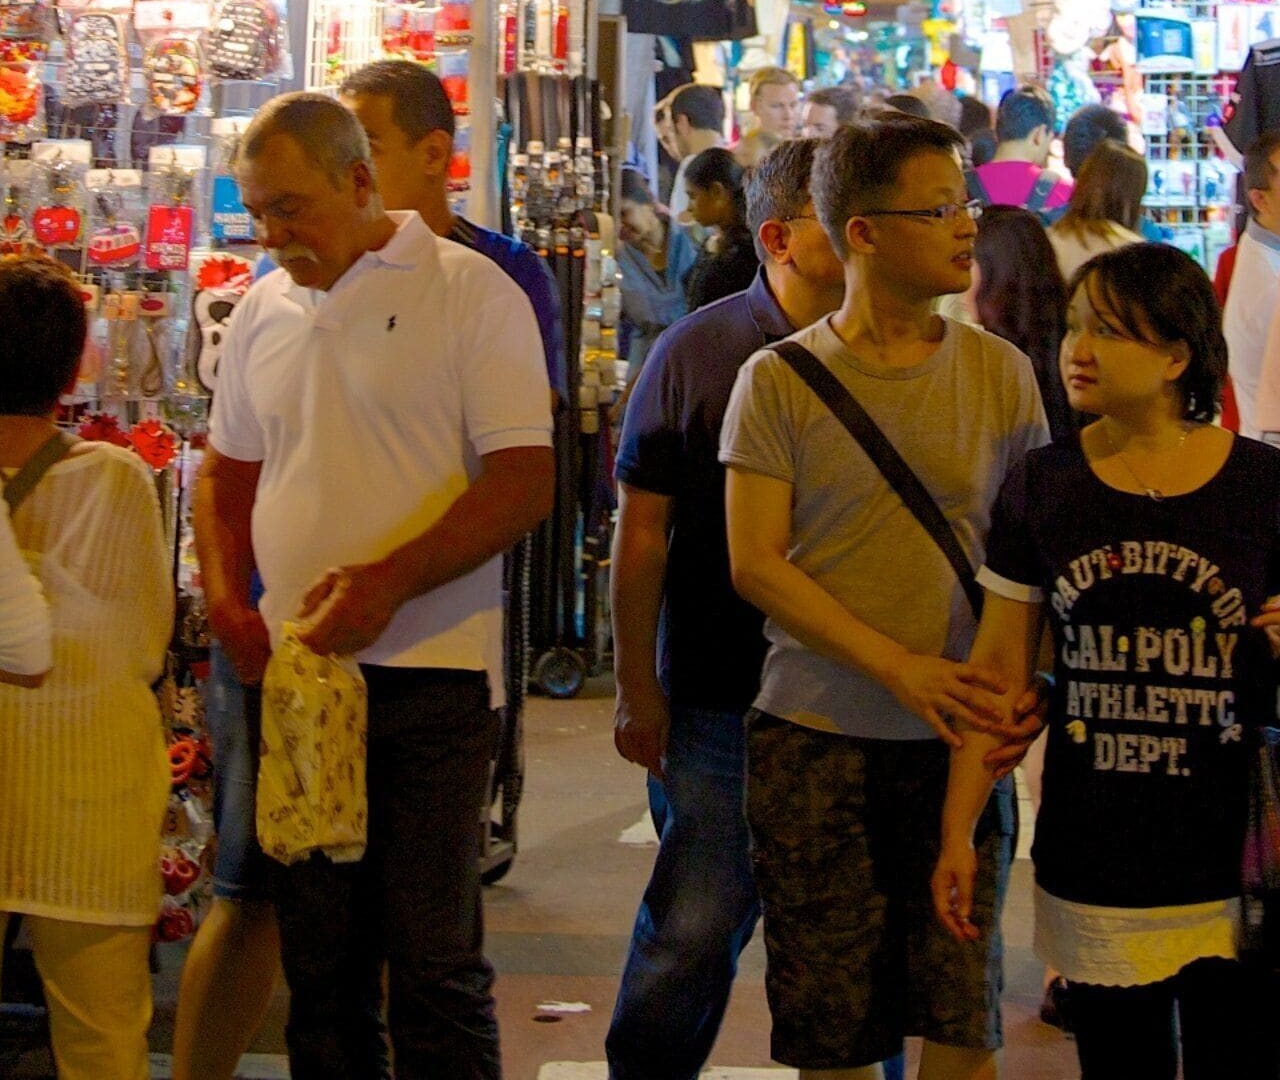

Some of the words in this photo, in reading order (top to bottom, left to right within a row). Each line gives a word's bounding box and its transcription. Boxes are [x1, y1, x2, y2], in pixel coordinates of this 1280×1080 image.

[1061, 624, 1128, 672] CAL
[1135, 627, 1239, 679] POLY
[1093, 730, 1192, 778] DEPT.
